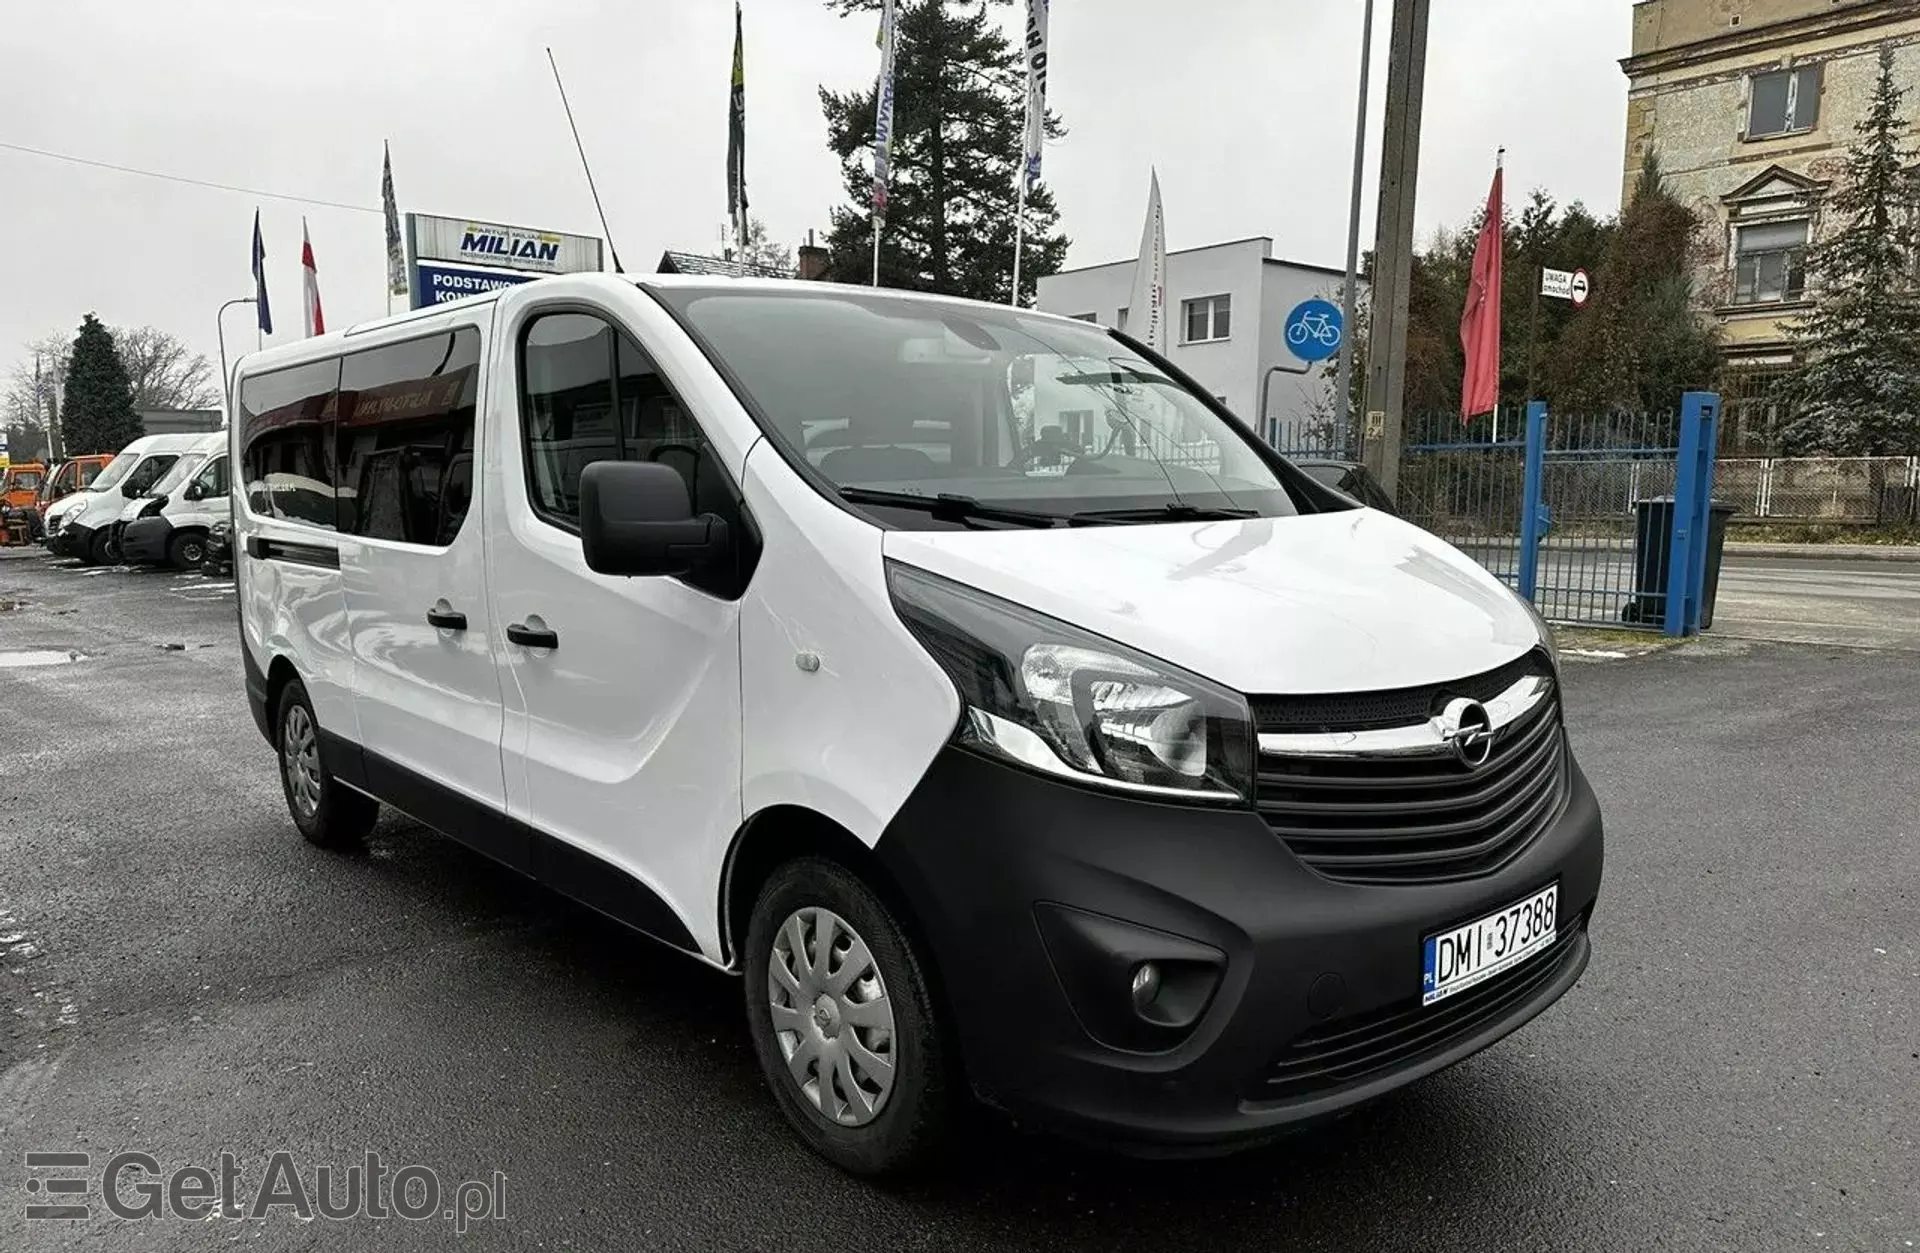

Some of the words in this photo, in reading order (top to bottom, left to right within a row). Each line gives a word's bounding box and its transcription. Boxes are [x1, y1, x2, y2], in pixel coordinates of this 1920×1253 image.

[461, 233, 559, 261] MILIAN
[1439, 924, 1482, 983] DMI
[1495, 892, 1555, 958] 37388
[1424, 972, 1434, 985] PL
